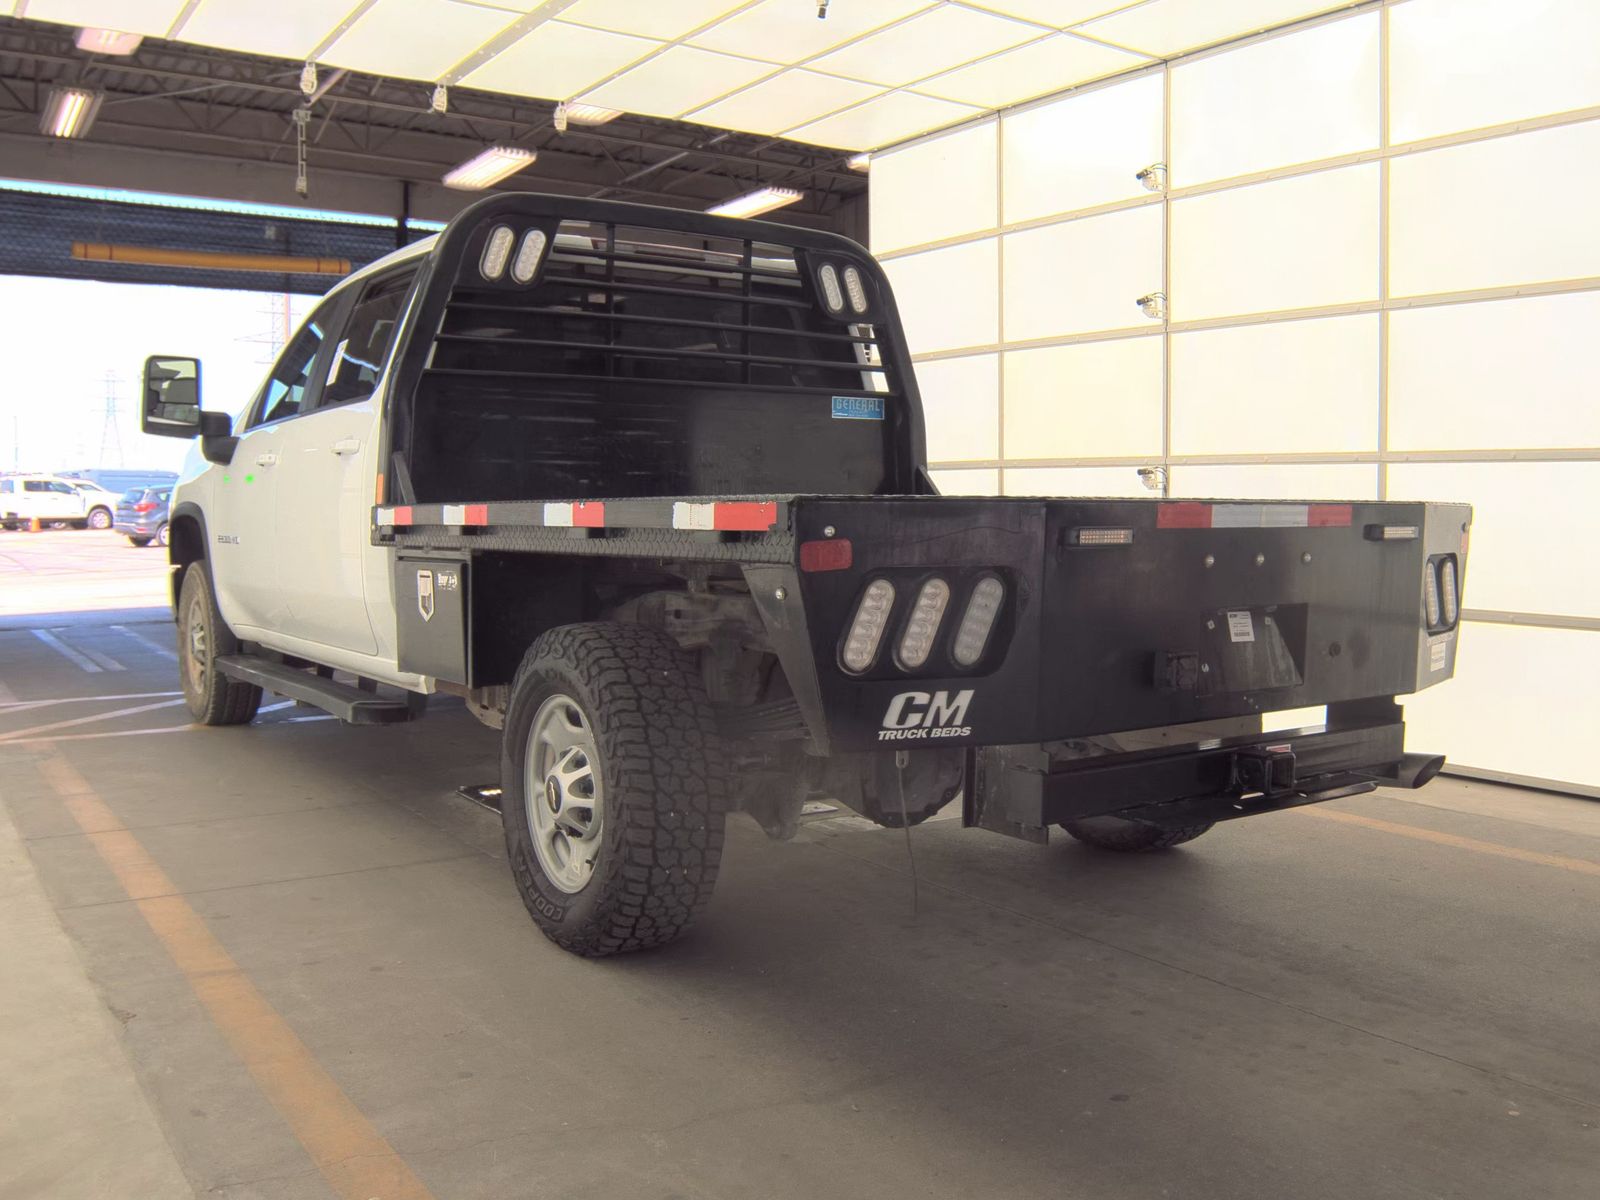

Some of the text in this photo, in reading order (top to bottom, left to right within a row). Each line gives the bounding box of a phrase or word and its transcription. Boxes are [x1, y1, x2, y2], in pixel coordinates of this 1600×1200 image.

[836, 399, 880, 411] GENERAL
[882, 689, 975, 729] CM
[878, 726, 972, 741] TRUCK BEDS
